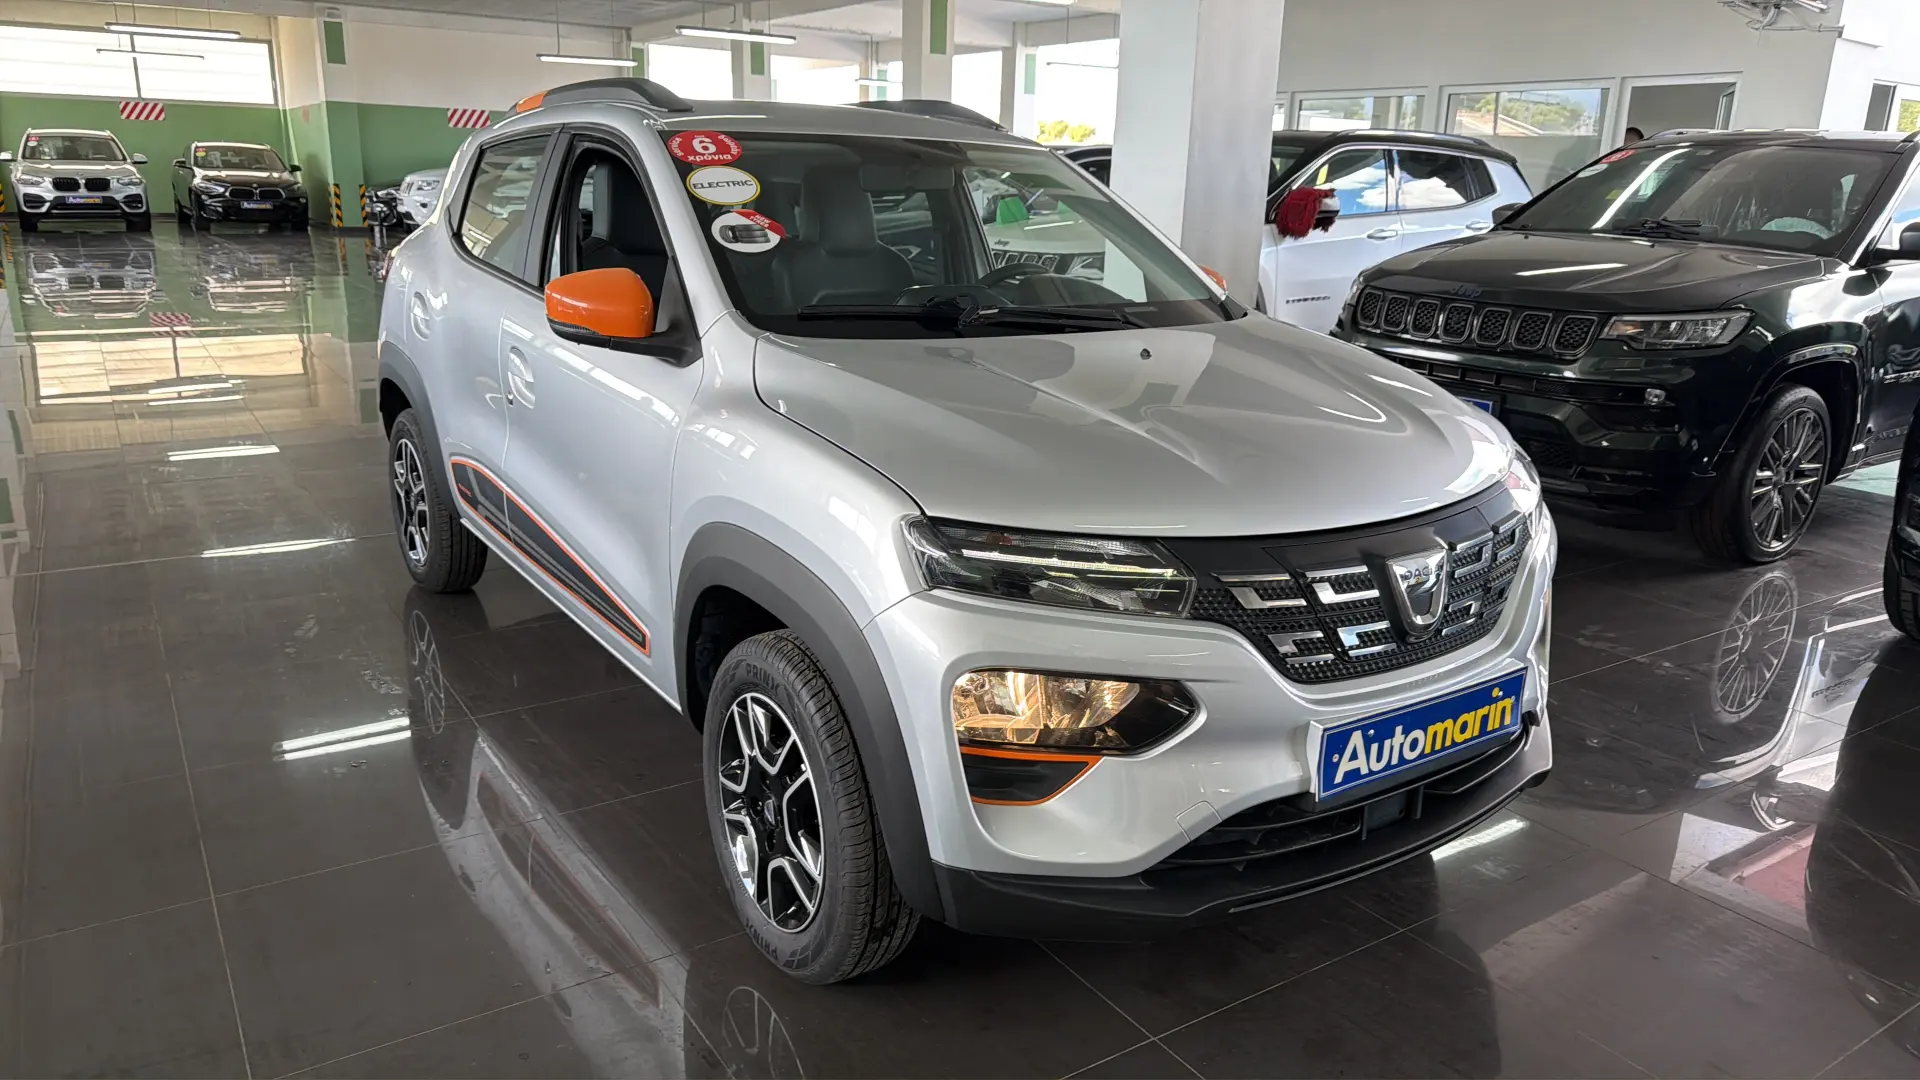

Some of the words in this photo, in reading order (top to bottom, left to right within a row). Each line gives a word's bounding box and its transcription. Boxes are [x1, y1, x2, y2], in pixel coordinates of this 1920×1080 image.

[692, 137, 717, 154] 6
[687, 153, 733, 162] χρόνια
[692, 179, 753, 190] ELECTRIC
[749, 216, 770, 228] TYRES
[755, 214, 772, 224] NEW
[1333, 687, 1513, 785] Automarin
